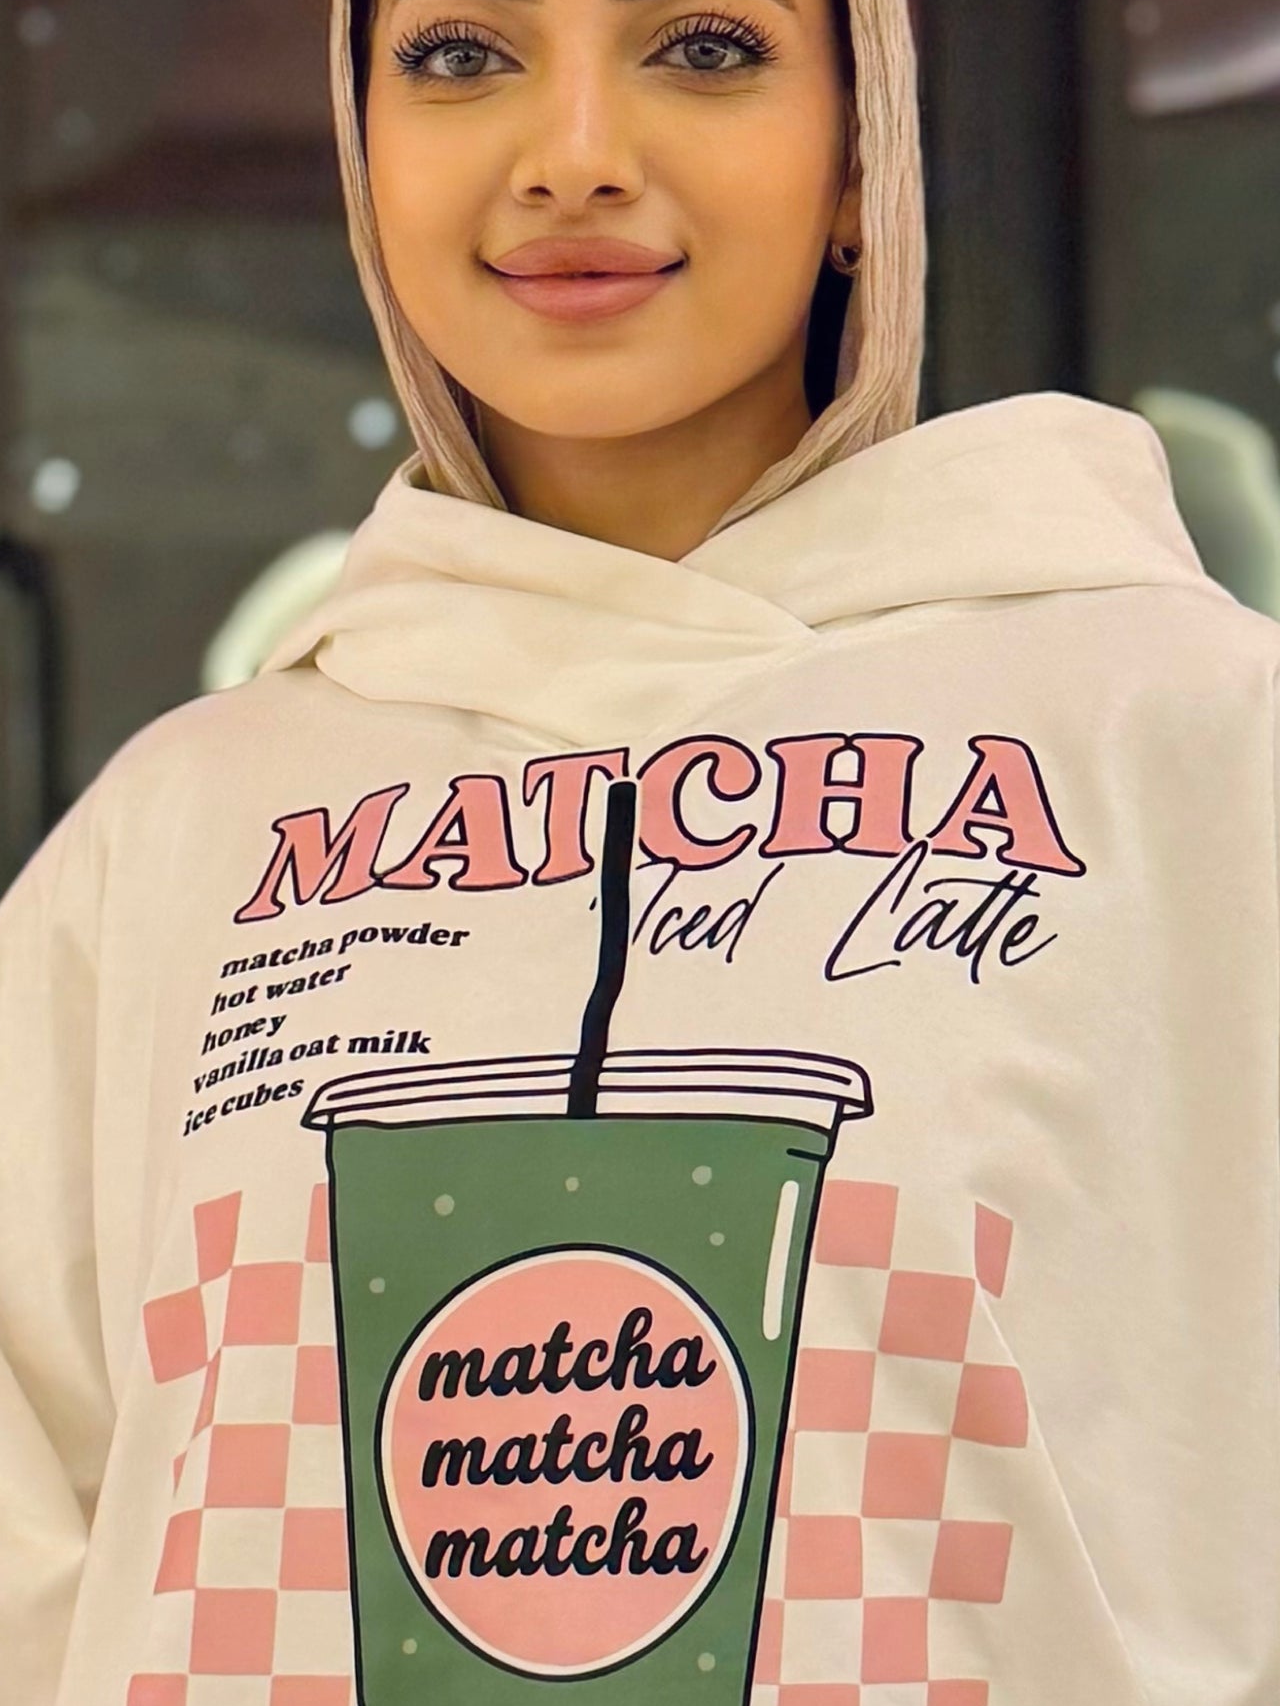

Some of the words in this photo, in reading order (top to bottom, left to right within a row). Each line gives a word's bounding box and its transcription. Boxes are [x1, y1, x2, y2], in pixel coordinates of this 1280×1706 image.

[233, 732, 1087, 925] MATCHA
[588, 857, 785, 964] Iced
[824, 839, 1058, 985] Latte
[220, 938, 334, 979] matcha
[338, 922, 470, 955] powder
[210, 985, 259, 1016] hot
[266, 963, 352, 1000] water
[193, 1047, 284, 1094] vanilla
[289, 1034, 341, 1061] oat
[347, 1030, 431, 1054] milk
[201, 1014, 287, 1056] honey
[183, 1103, 218, 1137] ice
[220, 1079, 305, 1116] cubes
[418, 1306, 717, 1402] matcha
[421, 1403, 714, 1488] matcha
[424, 1496, 709, 1579] matcha
